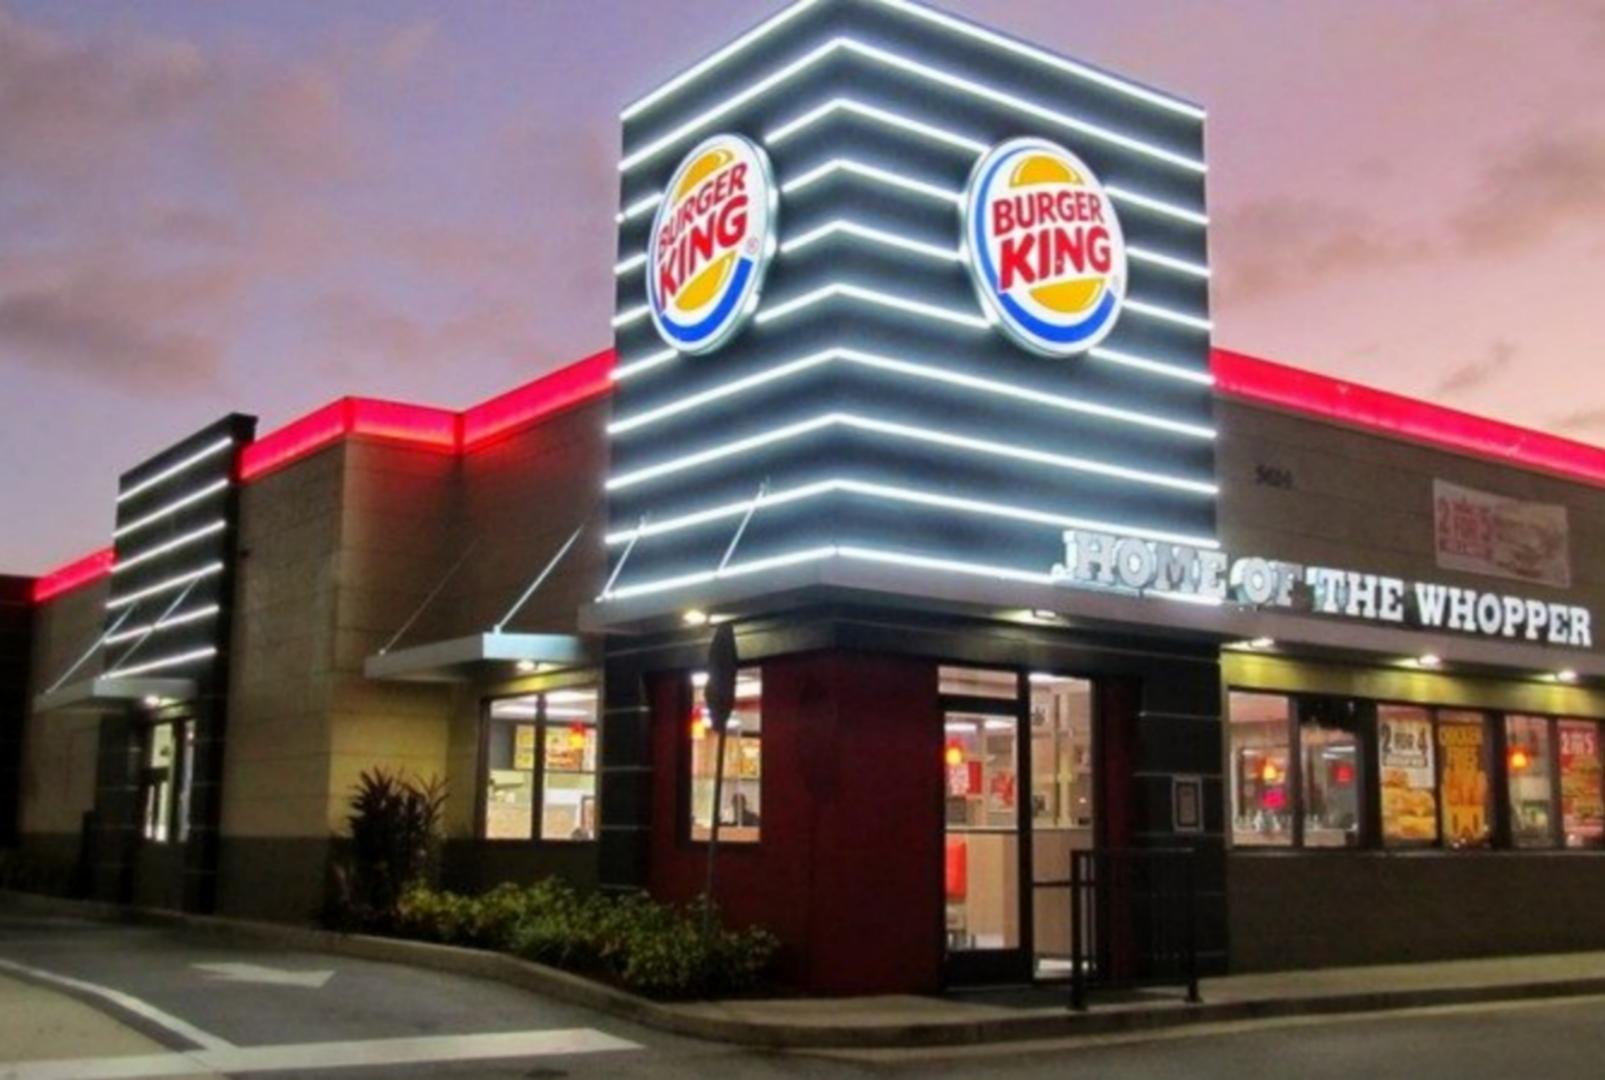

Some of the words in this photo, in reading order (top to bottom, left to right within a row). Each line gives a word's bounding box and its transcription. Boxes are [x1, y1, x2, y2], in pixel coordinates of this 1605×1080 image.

[658, 162, 747, 262] BURGER
[660, 195, 748, 311] KING
[993, 190, 1104, 237] BURGER
[1001, 226, 1111, 290] KING
[1055, 530, 1228, 600] HOME
[1231, 556, 1303, 606] OF
[1306, 566, 1404, 622] THE
[1415, 582, 1592, 647] WHOPPER
